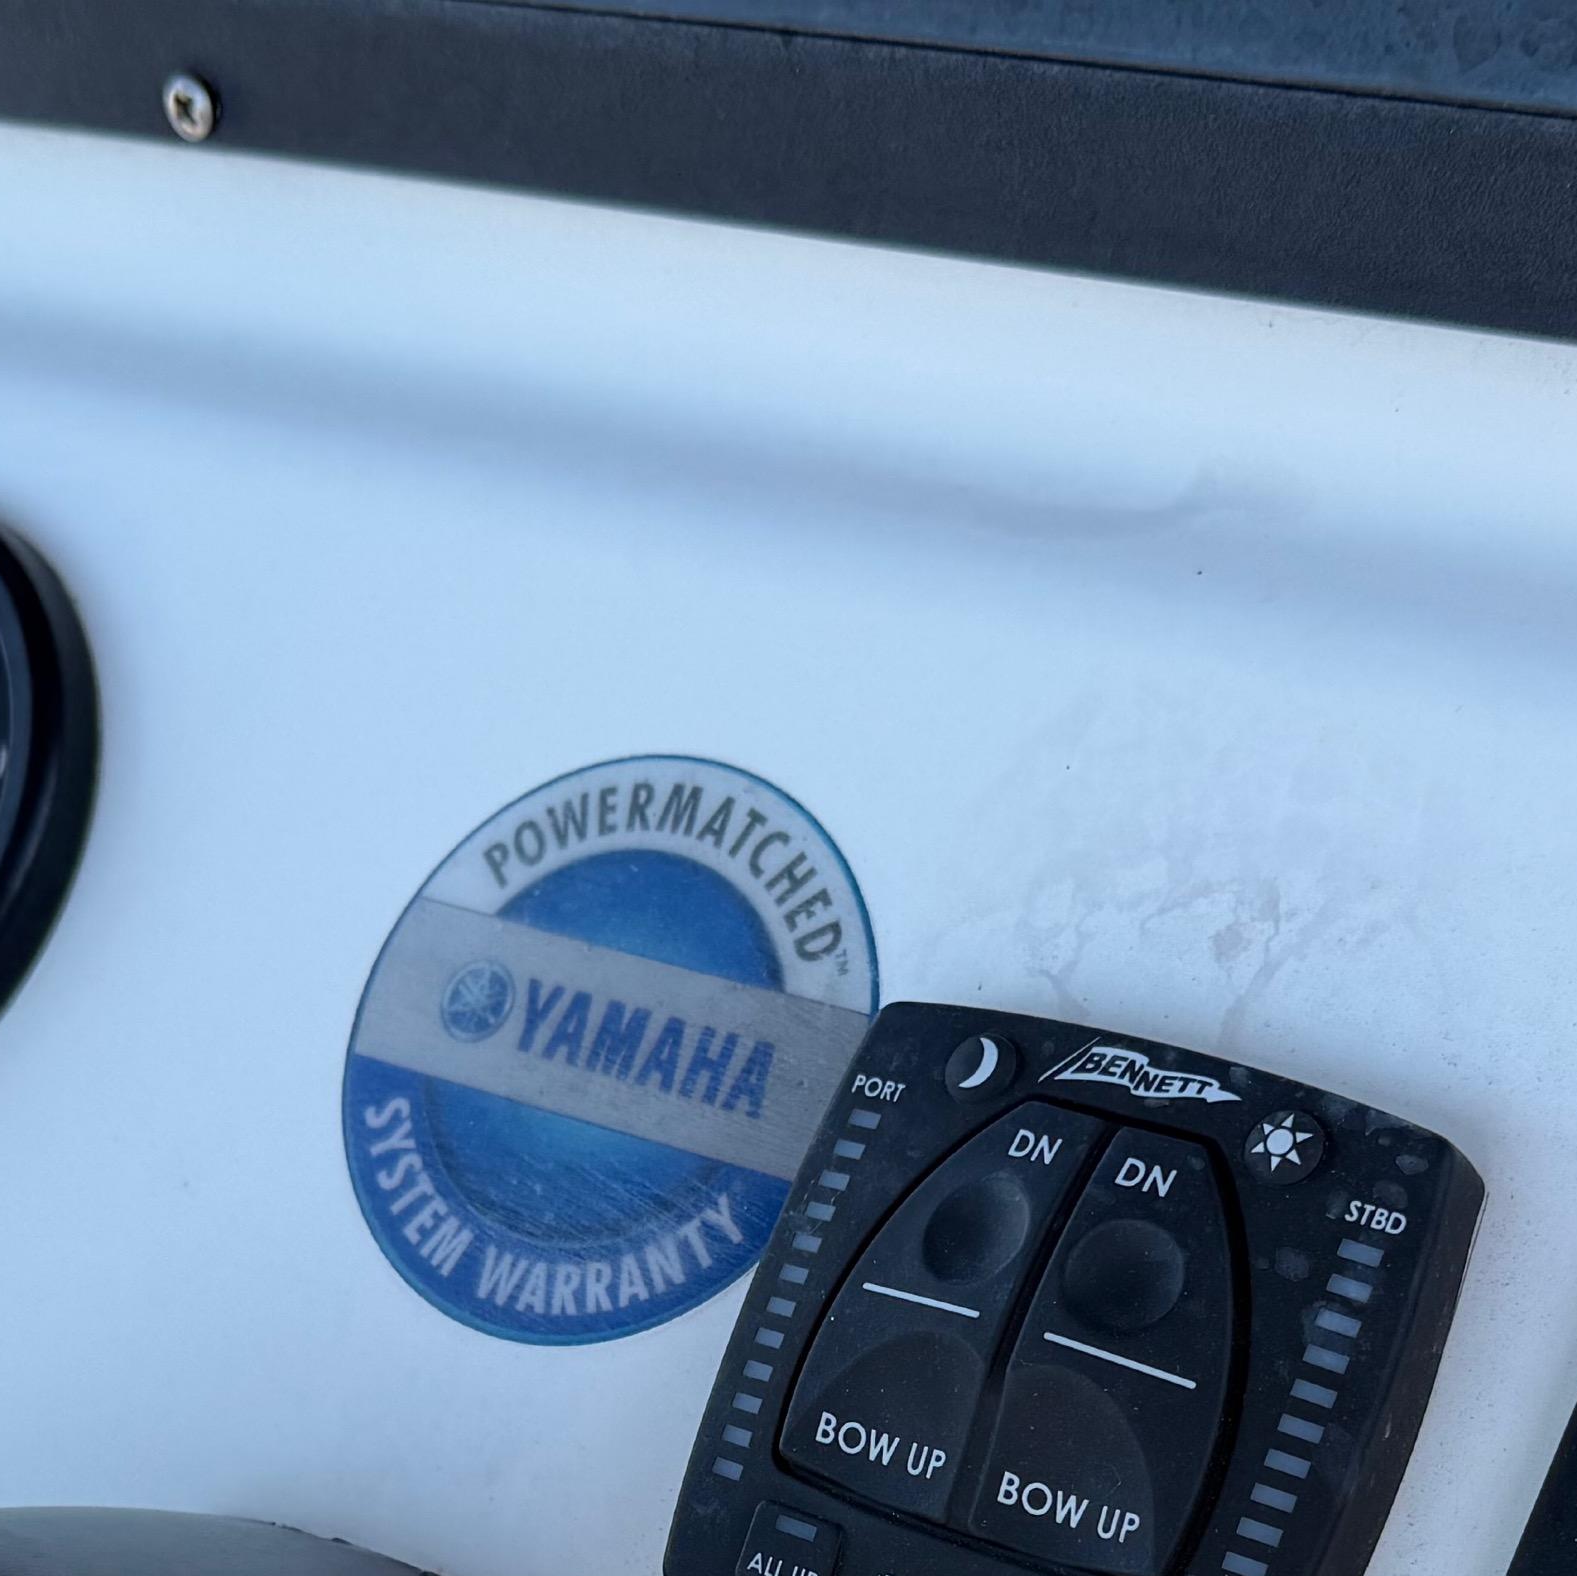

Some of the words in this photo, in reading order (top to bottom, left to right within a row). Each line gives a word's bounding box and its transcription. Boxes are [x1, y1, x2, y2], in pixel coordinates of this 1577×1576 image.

[517, 977, 777, 1121] YAMAHA
[851, 1073, 907, 1103] PORT
[1071, 1052, 1214, 1096] BENNETT
[1007, 1128, 1063, 1166] DN
[1114, 1156, 1178, 1198] DN
[364, 1097, 474, 1277] SYSTEM
[475, 1193, 744, 1316] WARRANTY
[1343, 1200, 1408, 1236] STBD
[815, 1411, 900, 1467] BOW
[906, 1442, 947, 1480] UP
[996, 1470, 1090, 1519] BOW
[1096, 1505, 1141, 1544] UP
